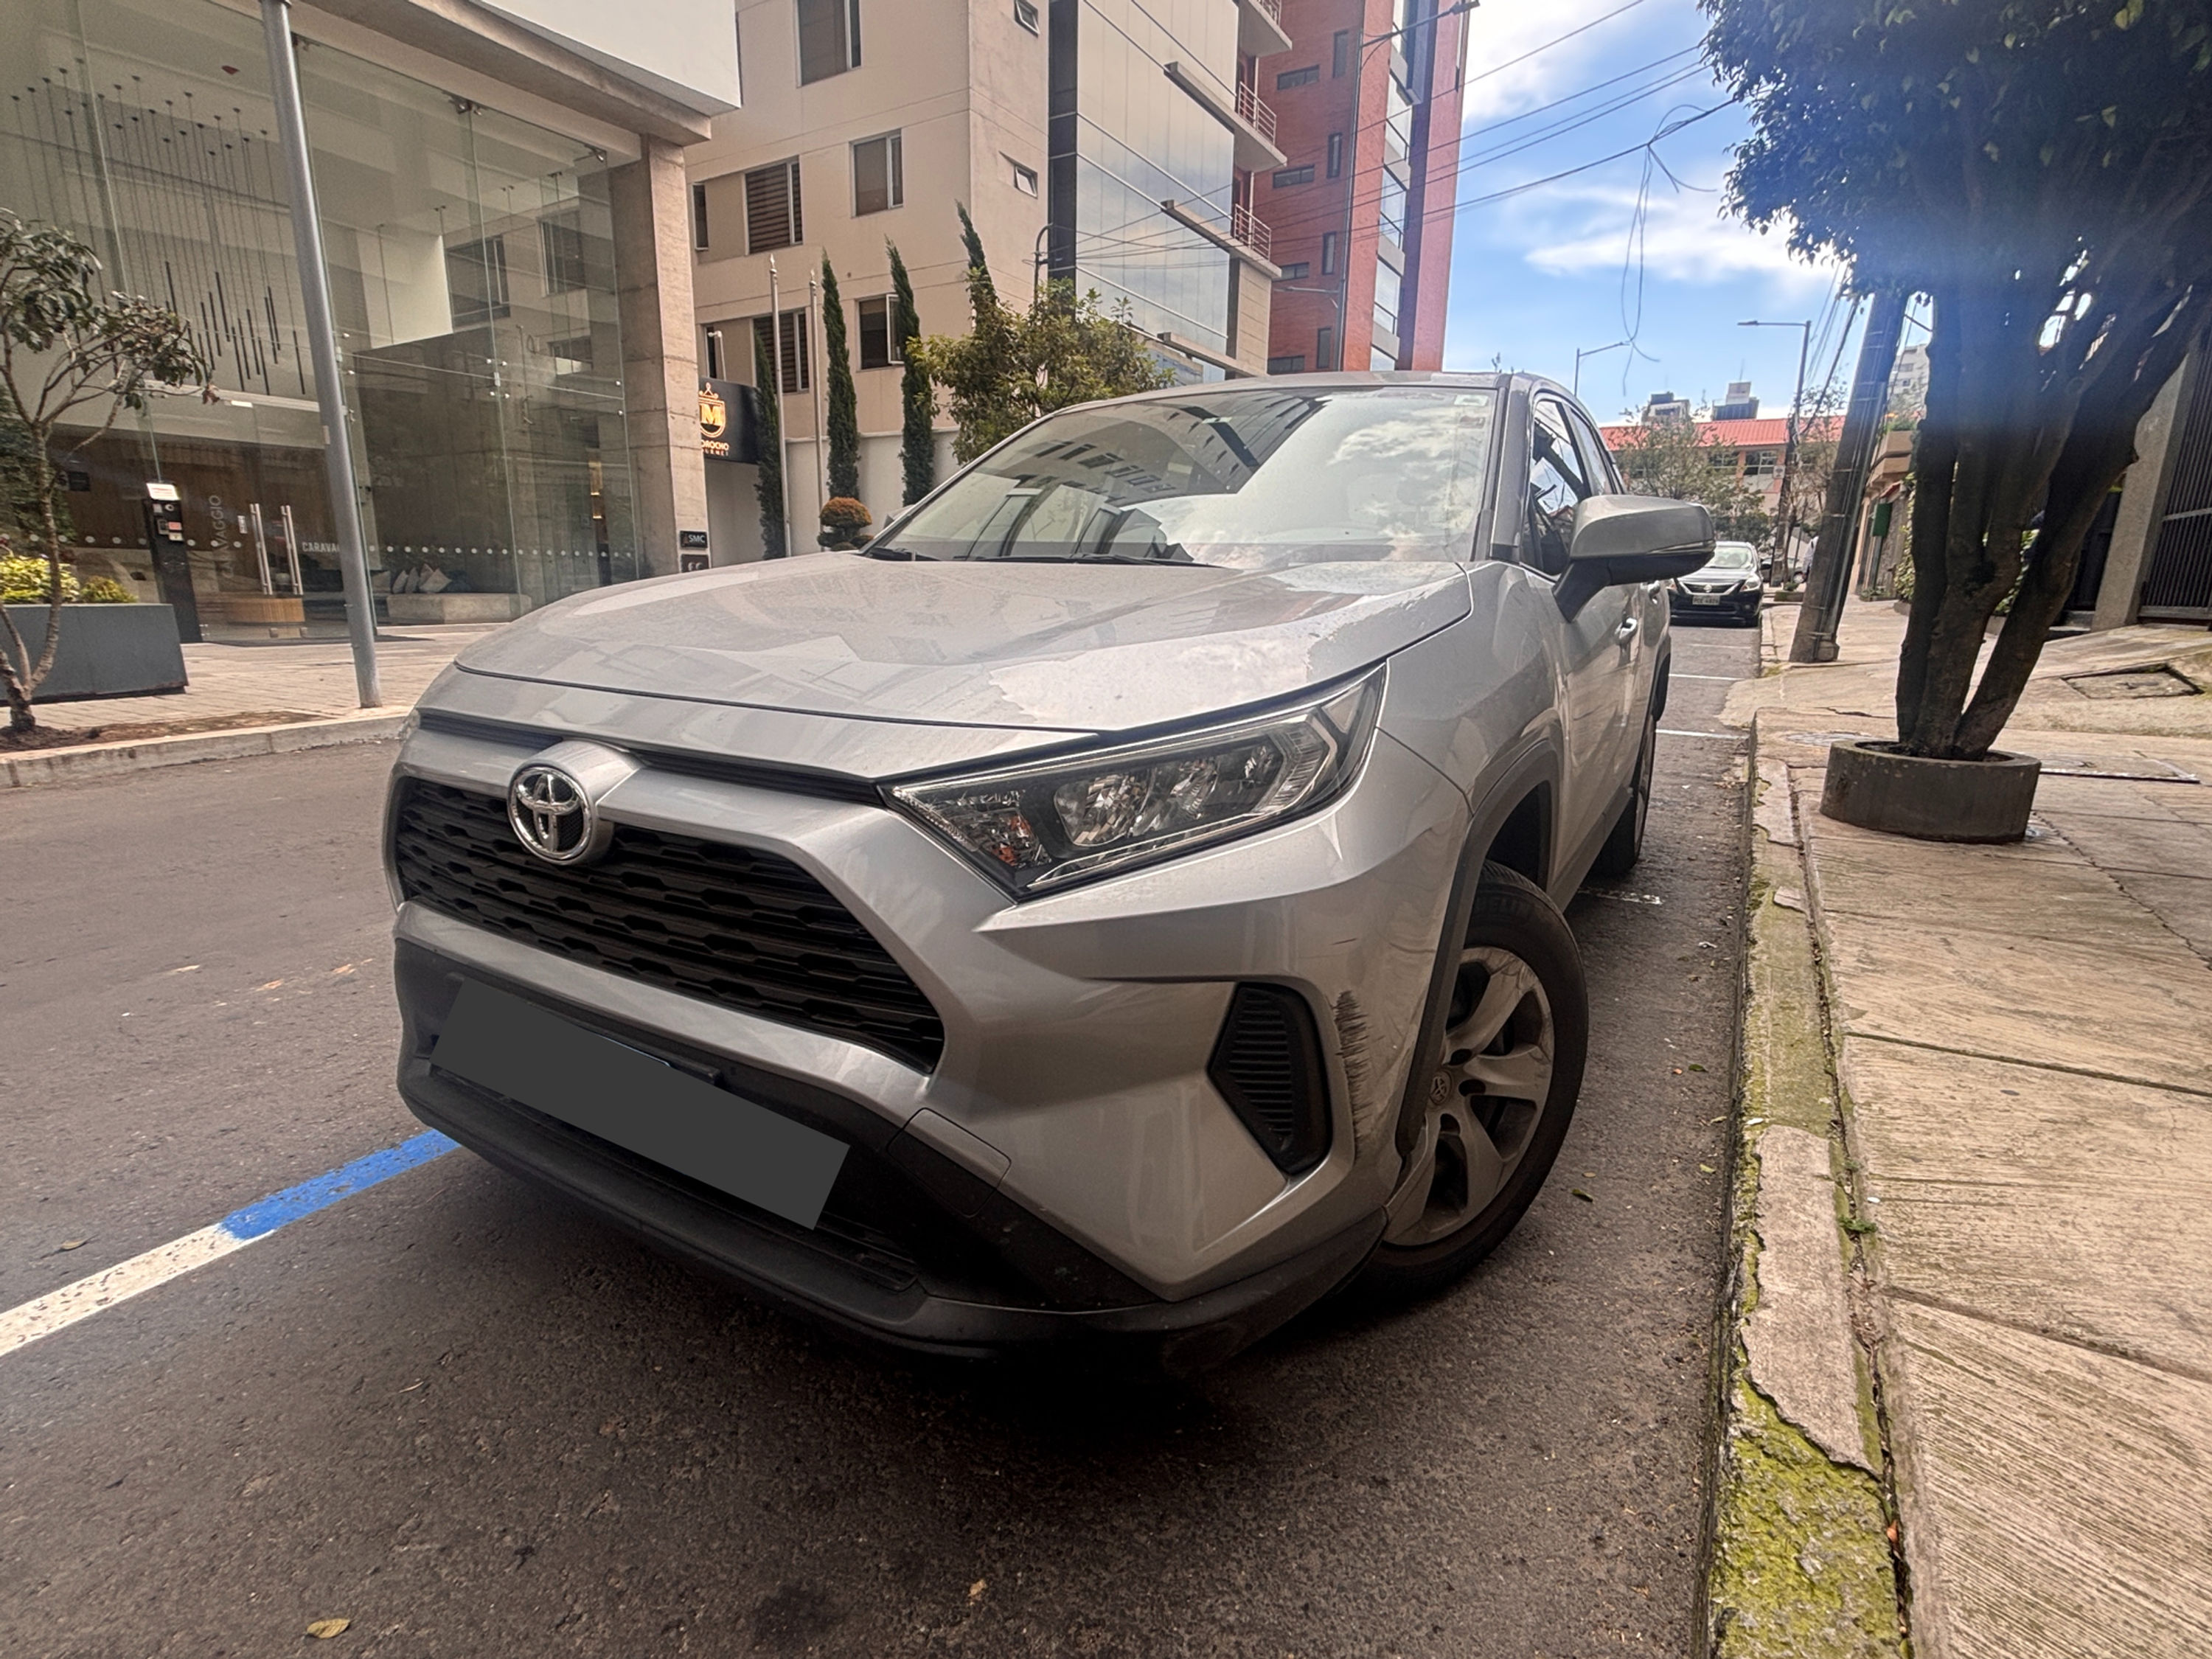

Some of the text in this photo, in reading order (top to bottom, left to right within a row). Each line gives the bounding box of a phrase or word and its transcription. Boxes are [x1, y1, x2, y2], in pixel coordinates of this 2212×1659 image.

[700, 404, 723, 426] M
[701, 439, 729, 451] OROCHO
[688, 535, 706, 543] SMC
[302, 541, 340, 553] CARAVA
